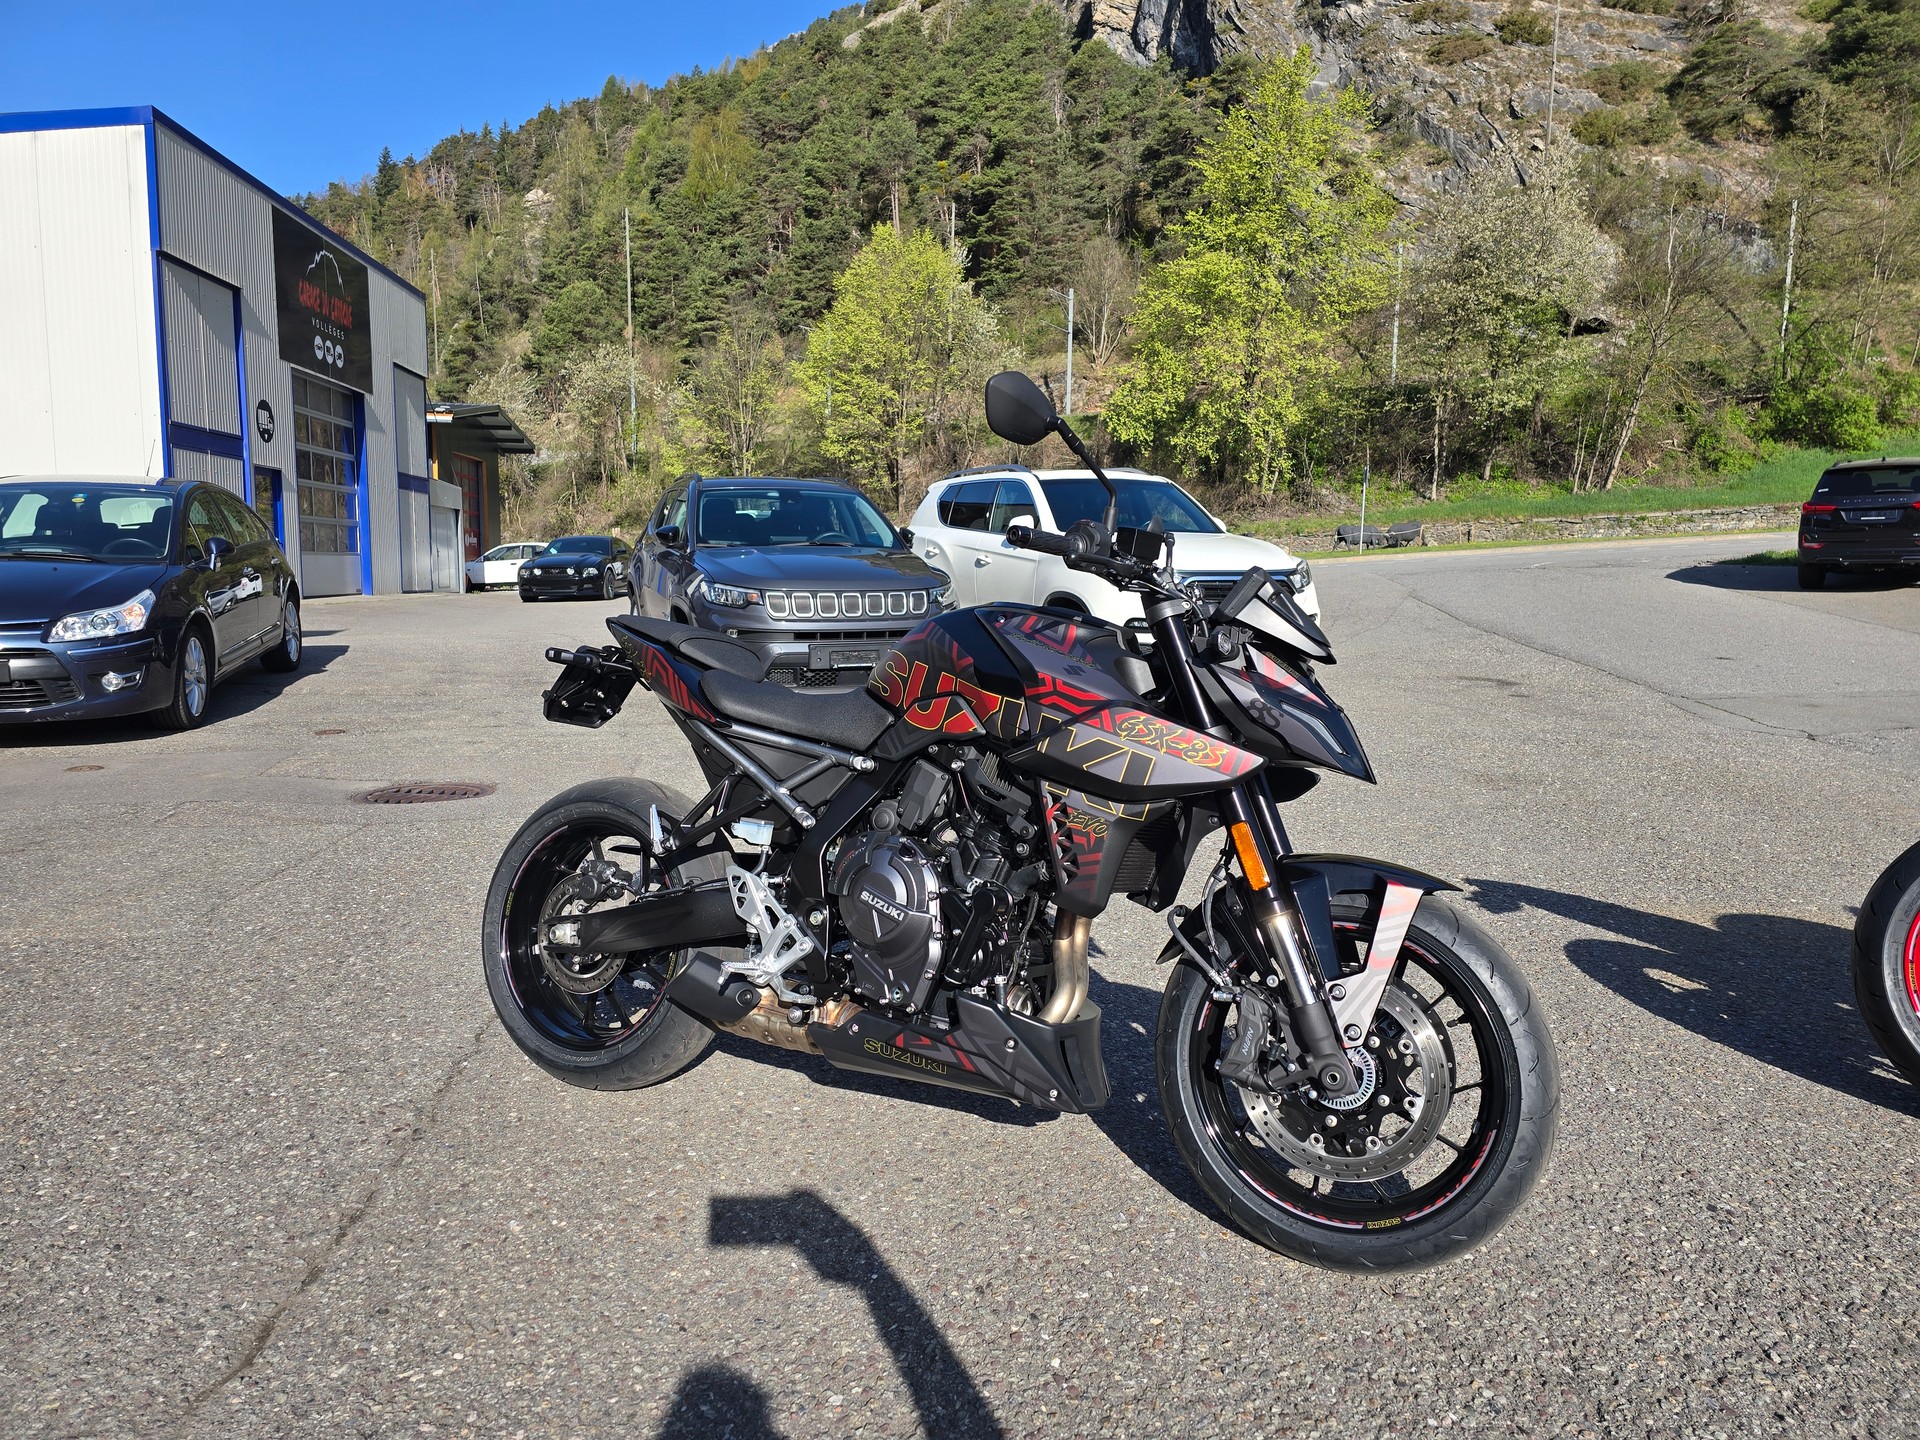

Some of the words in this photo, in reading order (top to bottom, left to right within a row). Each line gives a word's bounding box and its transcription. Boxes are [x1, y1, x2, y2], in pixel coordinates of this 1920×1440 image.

[312, 316, 345, 340] VOLLÈGES
[1116, 715, 1229, 766] GSX-8S
[860, 890, 905, 921] SUZUKI
[864, 1037, 947, 1075] SUZUKI
[1366, 1216, 1401, 1229] SUZUKI
